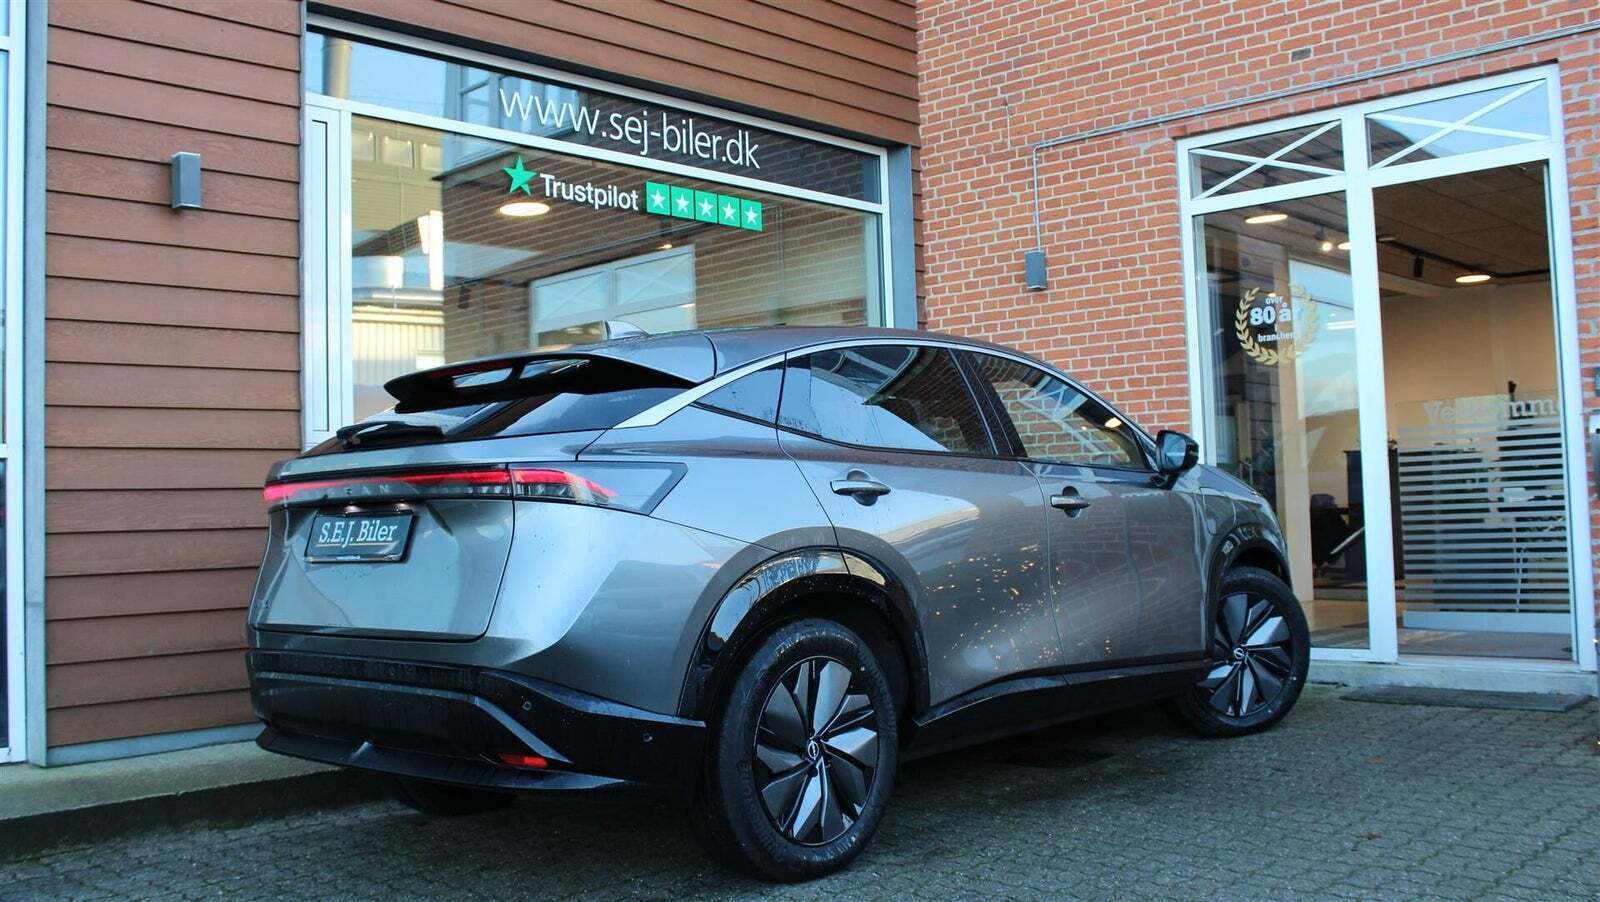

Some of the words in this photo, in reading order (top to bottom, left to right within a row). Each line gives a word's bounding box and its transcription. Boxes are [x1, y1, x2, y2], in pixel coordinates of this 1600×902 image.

[500, 88, 760, 169] www.sej-biler.dk
[540, 173, 639, 211] Trustpilot
[1249, 306, 1276, 325] 80
[318, 521, 355, 548] S.E.J.
[357, 520, 398, 541] Biler
